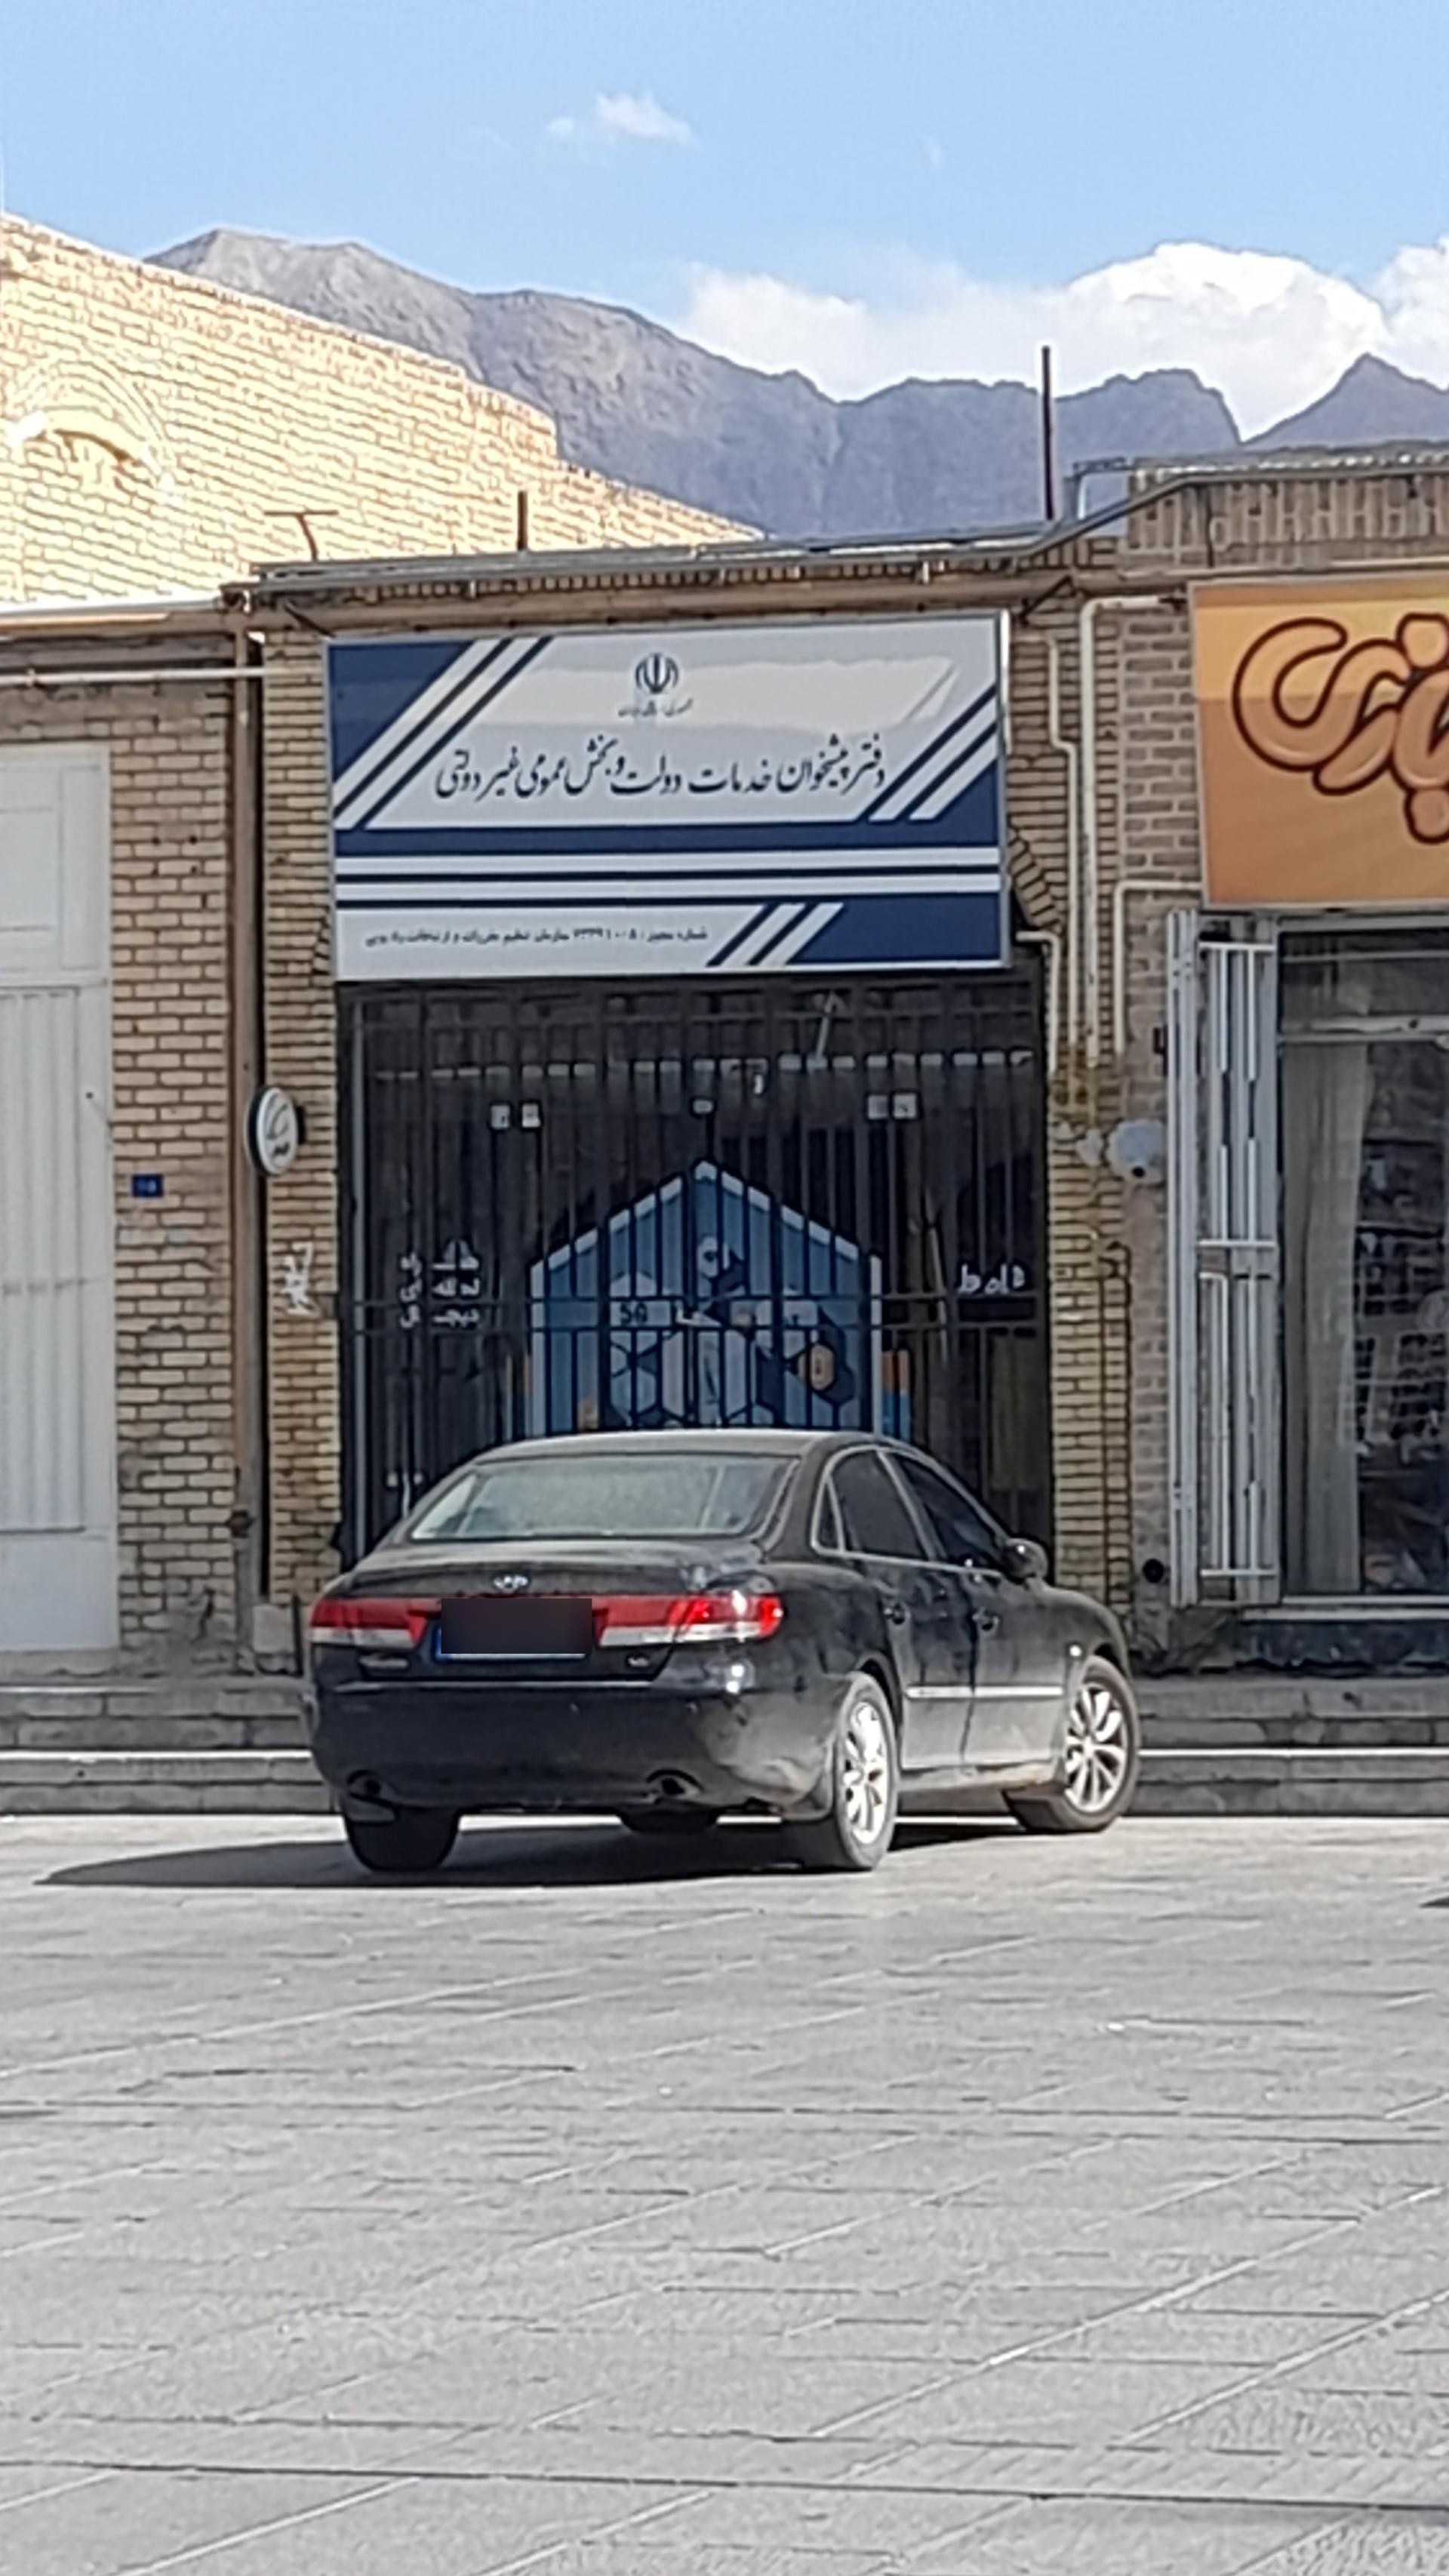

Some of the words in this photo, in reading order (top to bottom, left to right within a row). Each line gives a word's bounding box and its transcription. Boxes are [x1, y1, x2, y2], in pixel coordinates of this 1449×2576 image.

[515, 753, 568, 798] عمومی
[565, 734, 619, 796] بخش
[610, 754, 681, 795] دولت
[688, 759, 772, 793] خدمات
[777, 733, 850, 793] پیشخوان
[841, 732, 886, 795] دفتر
